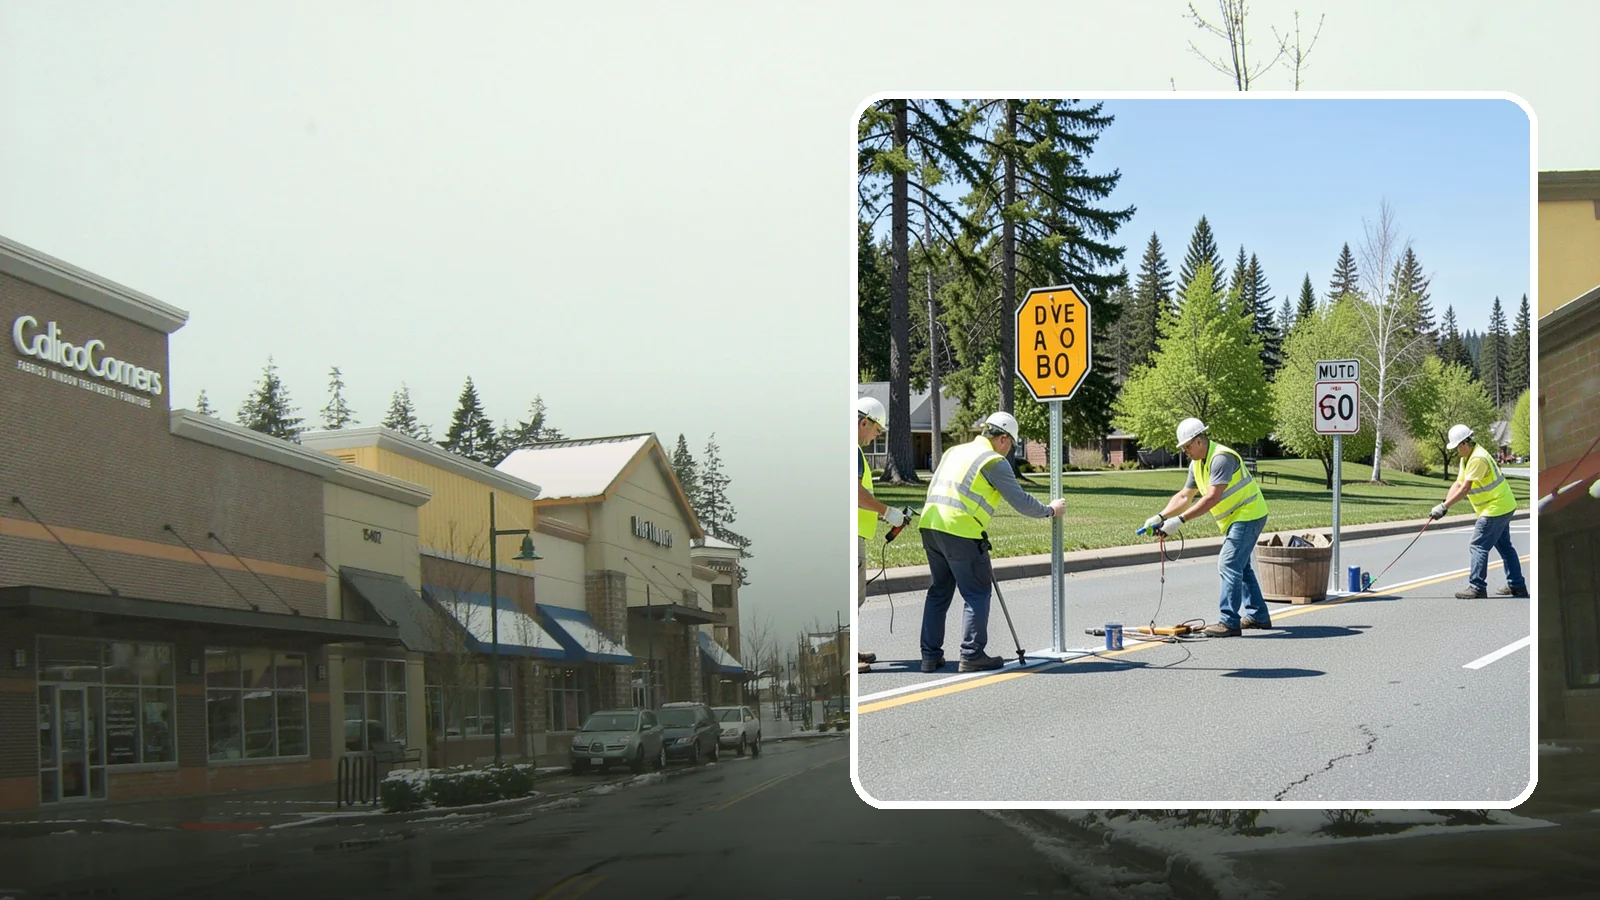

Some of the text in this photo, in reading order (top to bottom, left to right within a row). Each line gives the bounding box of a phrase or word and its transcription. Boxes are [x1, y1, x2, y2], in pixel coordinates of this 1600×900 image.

[1034, 327, 1075, 351] A O
[17, 360, 47, 377] FABRICS
[1037, 353, 1070, 379] BO
[1318, 394, 1354, 421] 60
